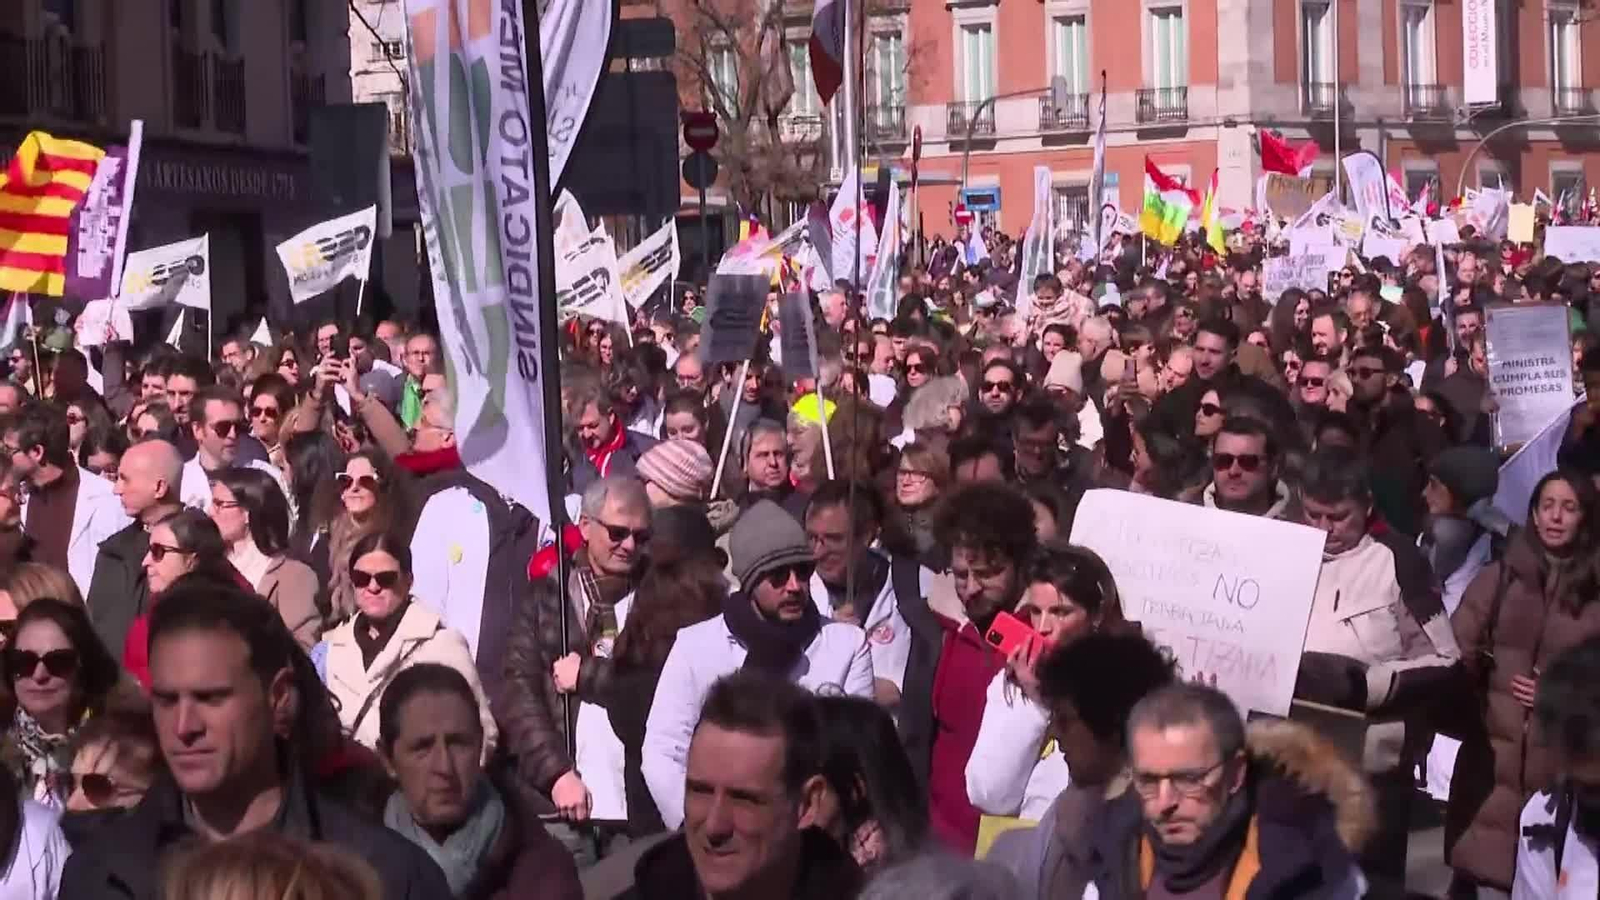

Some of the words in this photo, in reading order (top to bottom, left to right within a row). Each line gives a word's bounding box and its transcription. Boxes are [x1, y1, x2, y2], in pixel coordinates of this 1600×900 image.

[1502, 357, 1557, 369] MINISTRA
[1493, 371, 1542, 384] CUMPLA
[1499, 386, 1563, 397] PROMESAS
[1212, 572, 1261, 611] NO
